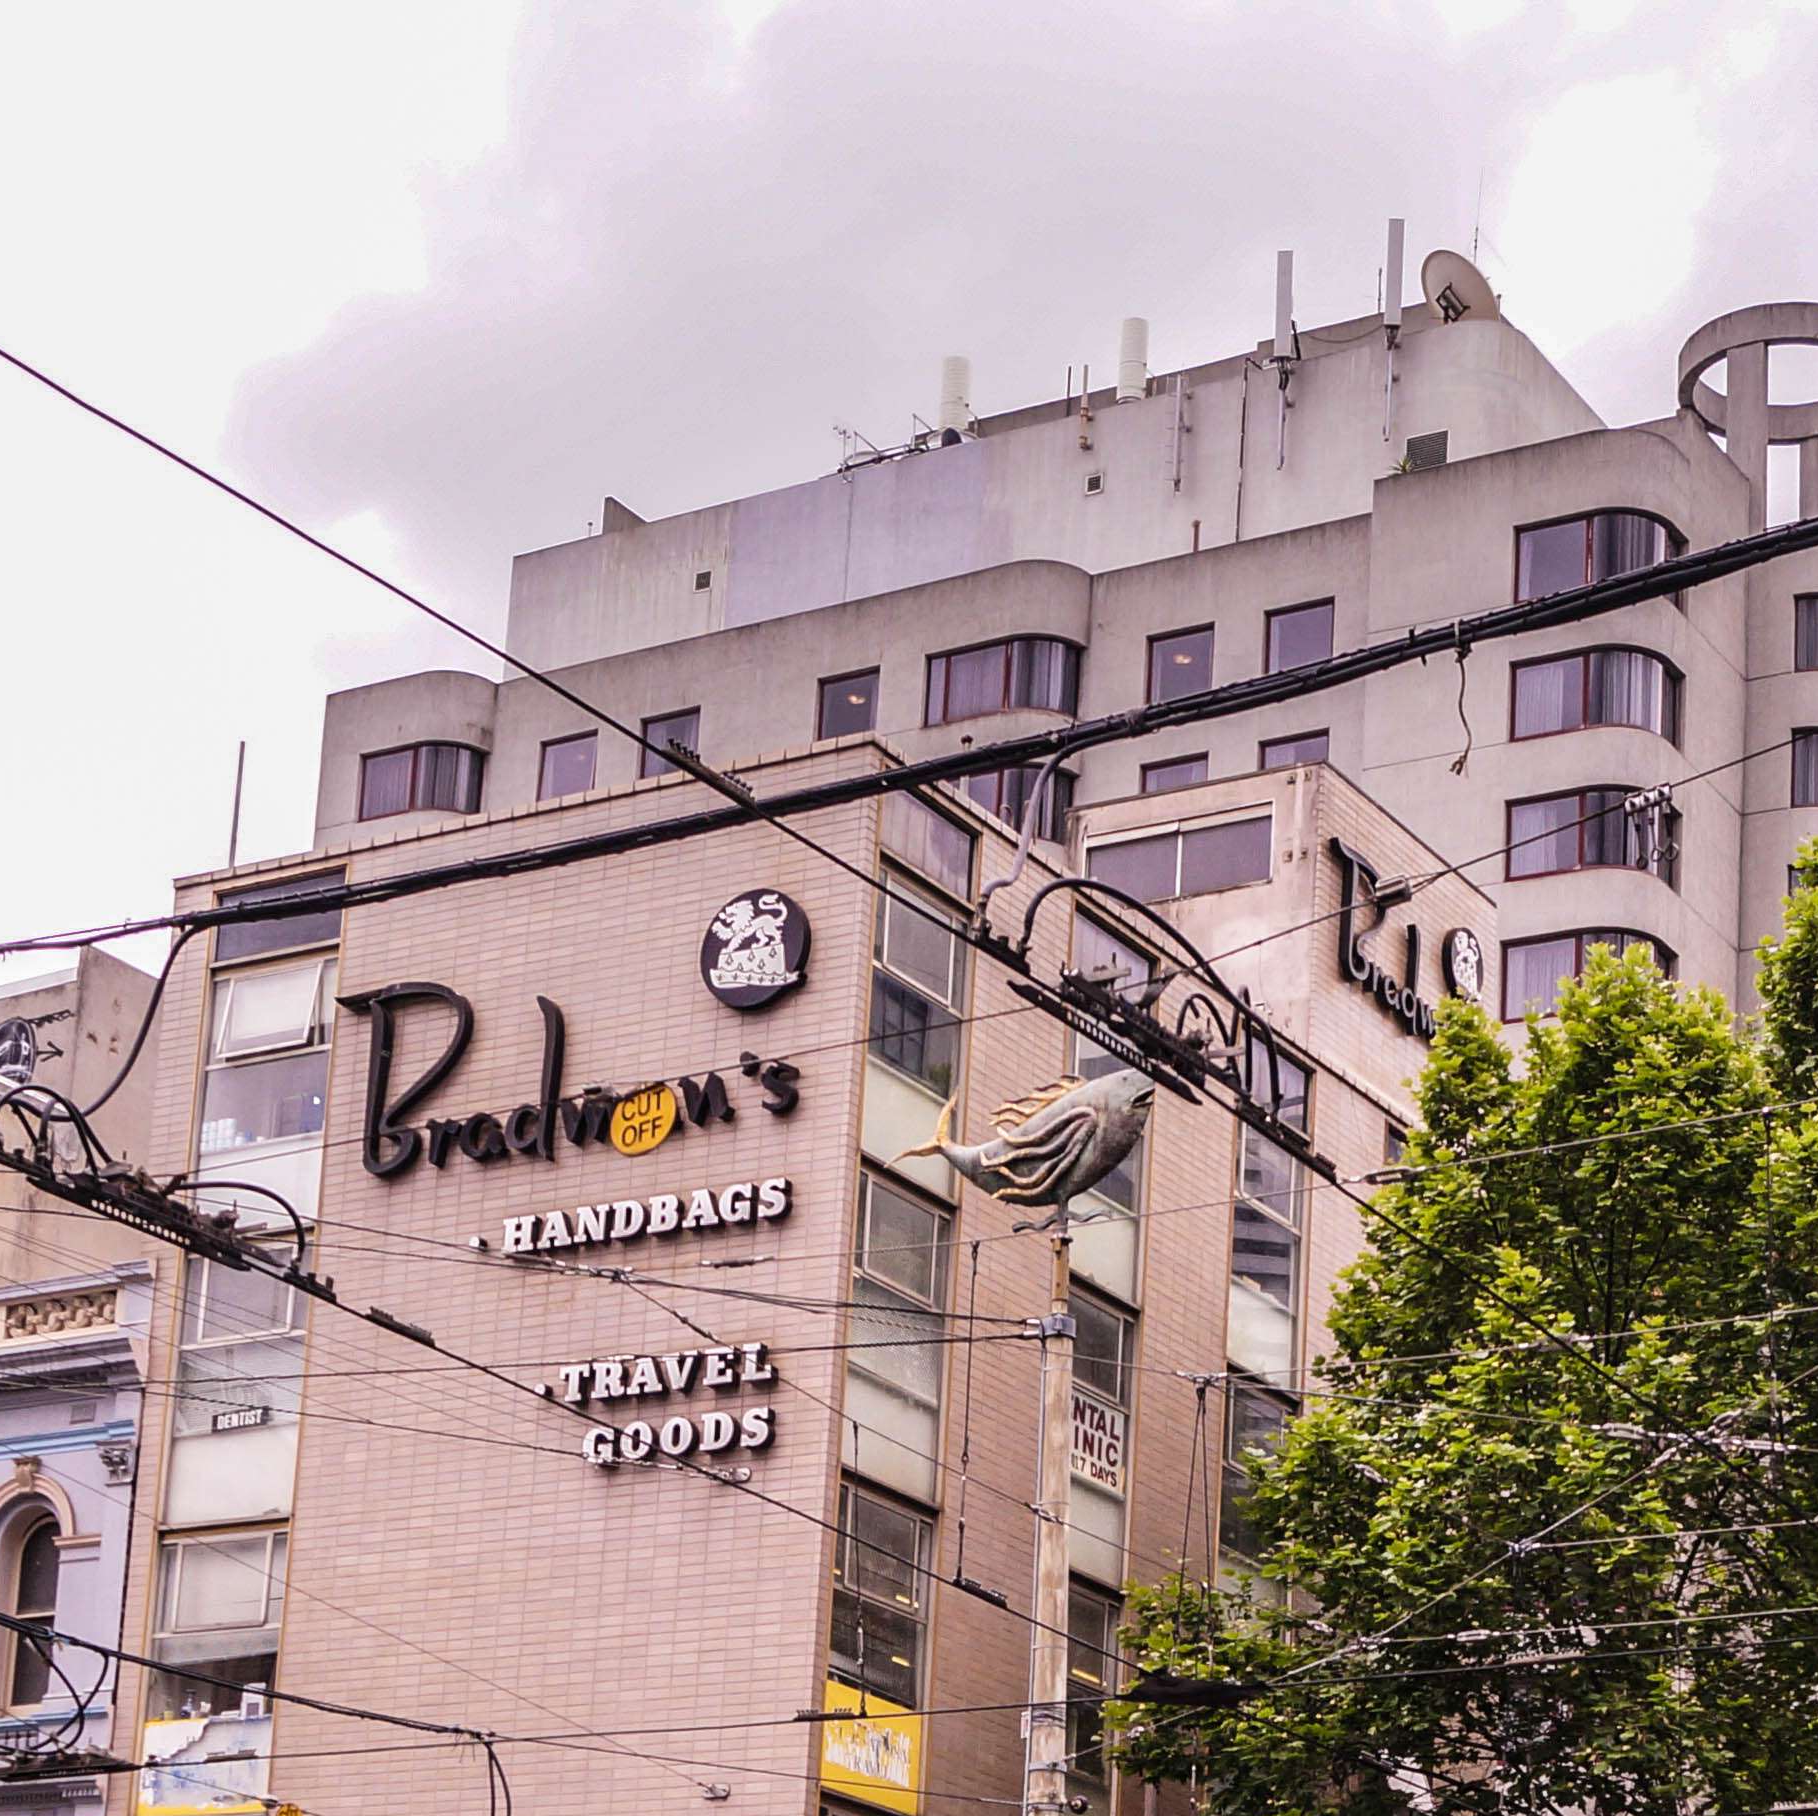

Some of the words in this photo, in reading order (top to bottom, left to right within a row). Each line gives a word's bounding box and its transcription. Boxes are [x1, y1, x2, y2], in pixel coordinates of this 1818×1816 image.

[621, 1086, 665, 1123] CUT
[621, 1119, 663, 1148] OFF
[500, 1177, 790, 1254] HANDBAGS
[559, 1342, 776, 1402] TRAVEL
[217, 1409, 263, 1430] DENTIST
[582, 1407, 773, 1464] GOODS
[1072, 1394, 1120, 1442] NTAL
[1074, 1425, 1119, 1467] INIC
[1090, 1461, 1117, 1487] DAYS
